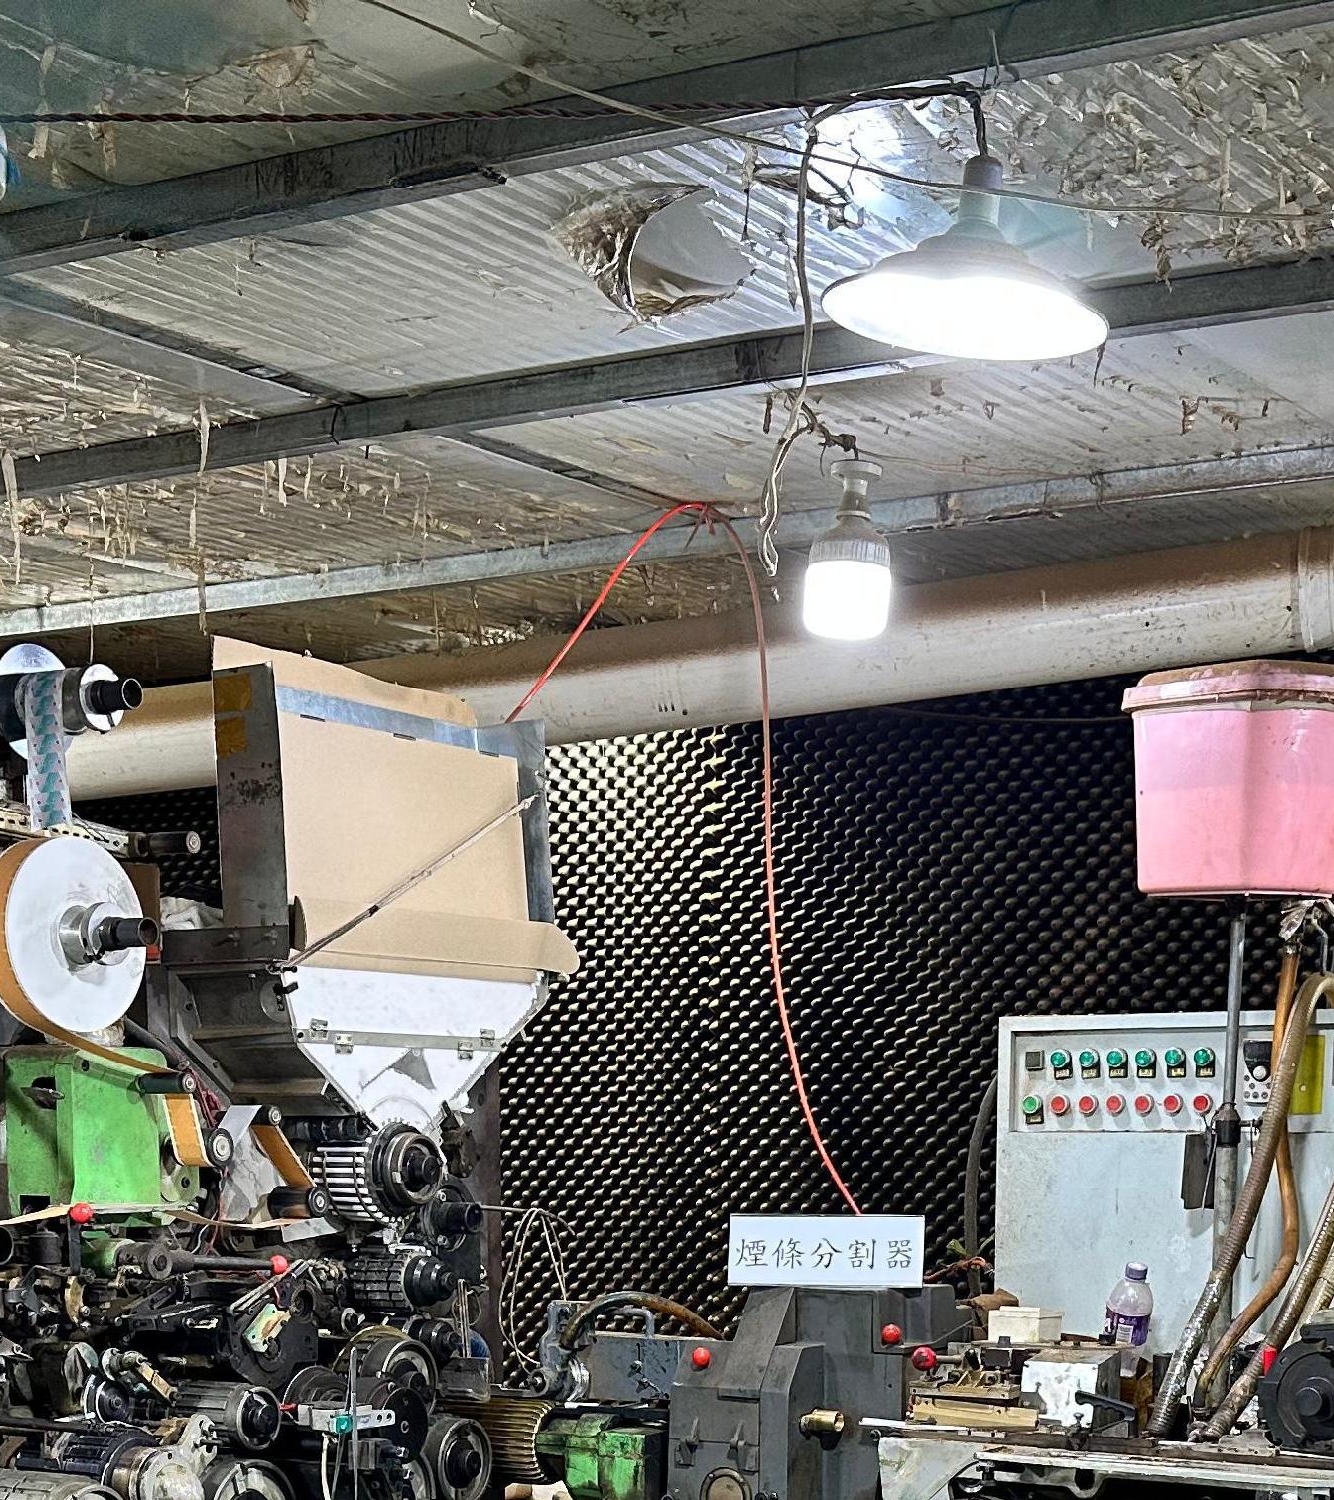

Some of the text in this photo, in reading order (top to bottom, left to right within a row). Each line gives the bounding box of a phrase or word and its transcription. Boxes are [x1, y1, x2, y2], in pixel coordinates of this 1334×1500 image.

[735, 1237, 913, 1270] 煙條分割器
